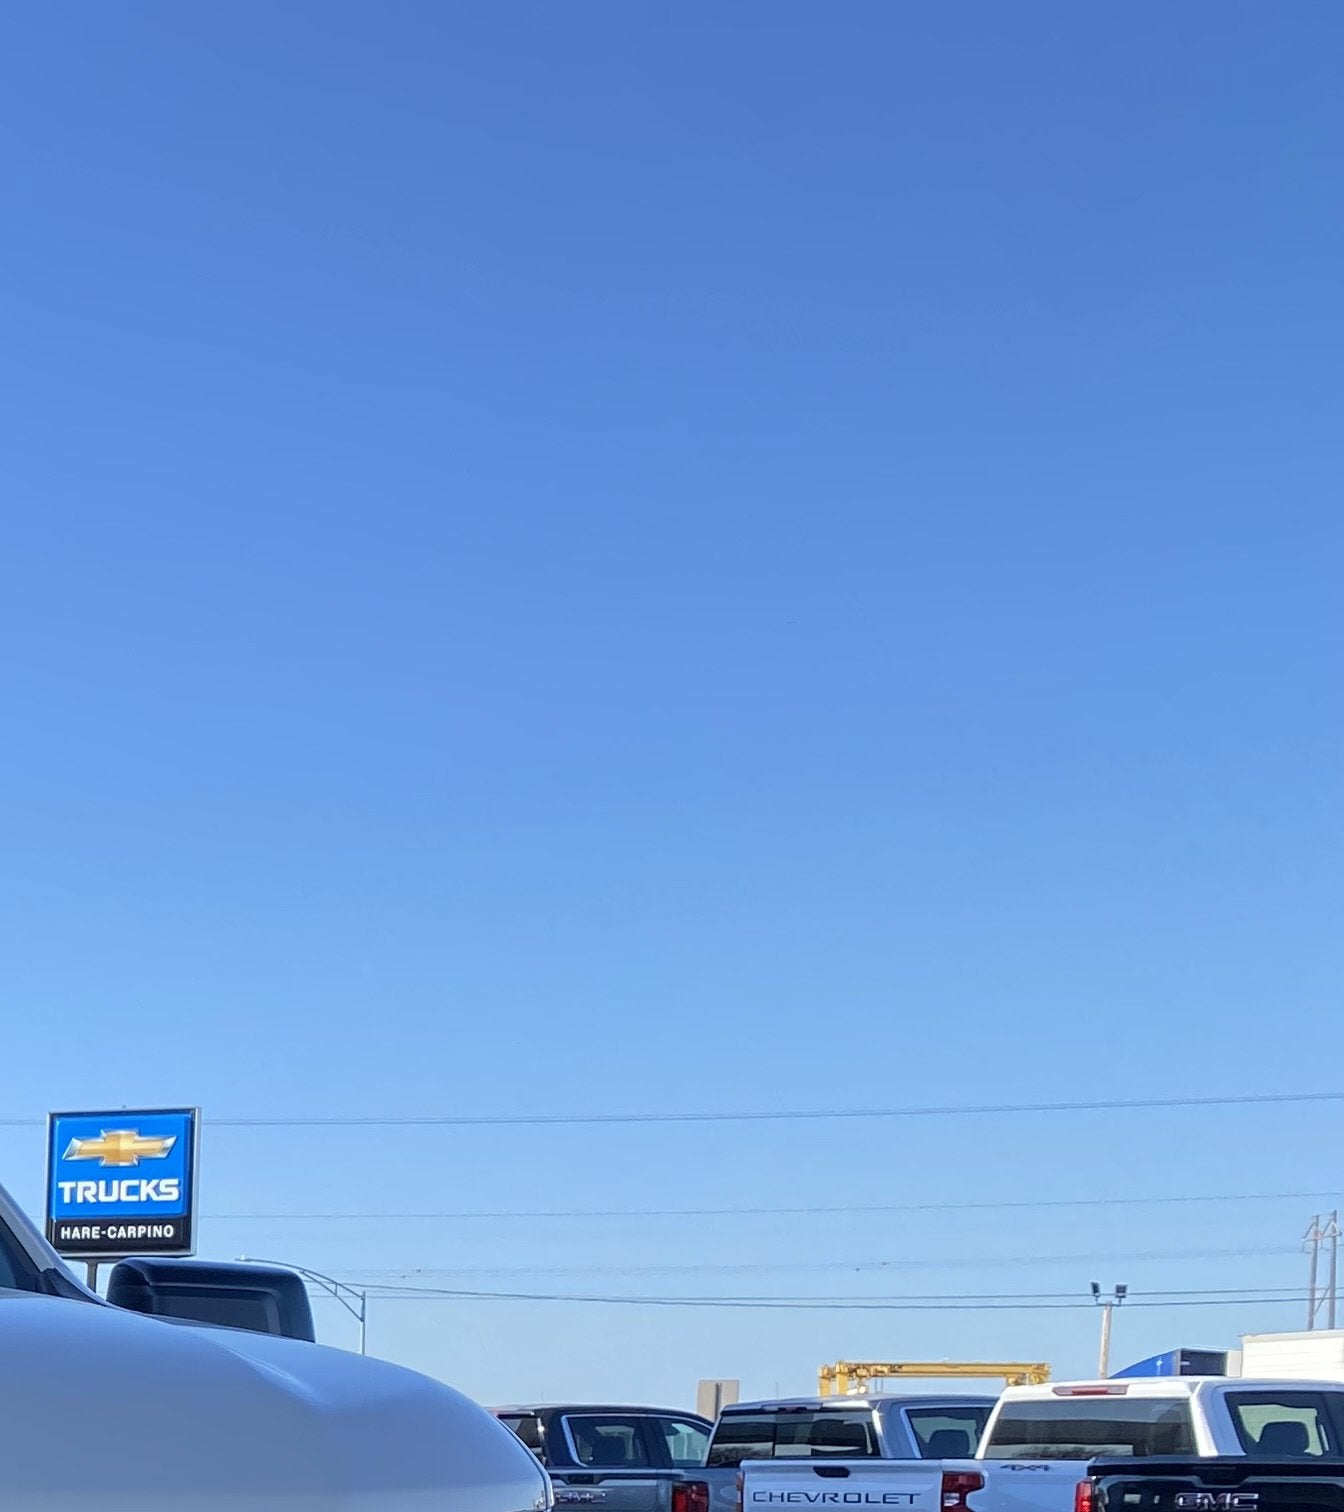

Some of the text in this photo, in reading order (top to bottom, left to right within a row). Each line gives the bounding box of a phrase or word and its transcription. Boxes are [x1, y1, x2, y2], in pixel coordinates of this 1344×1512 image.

[57, 1178, 179, 1203] TRUCKS
[61, 1225, 174, 1239] HARE-CARPINO
[752, 1491, 922, 1505] CHEVROLET
[1174, 1493, 1259, 1511] GMC
